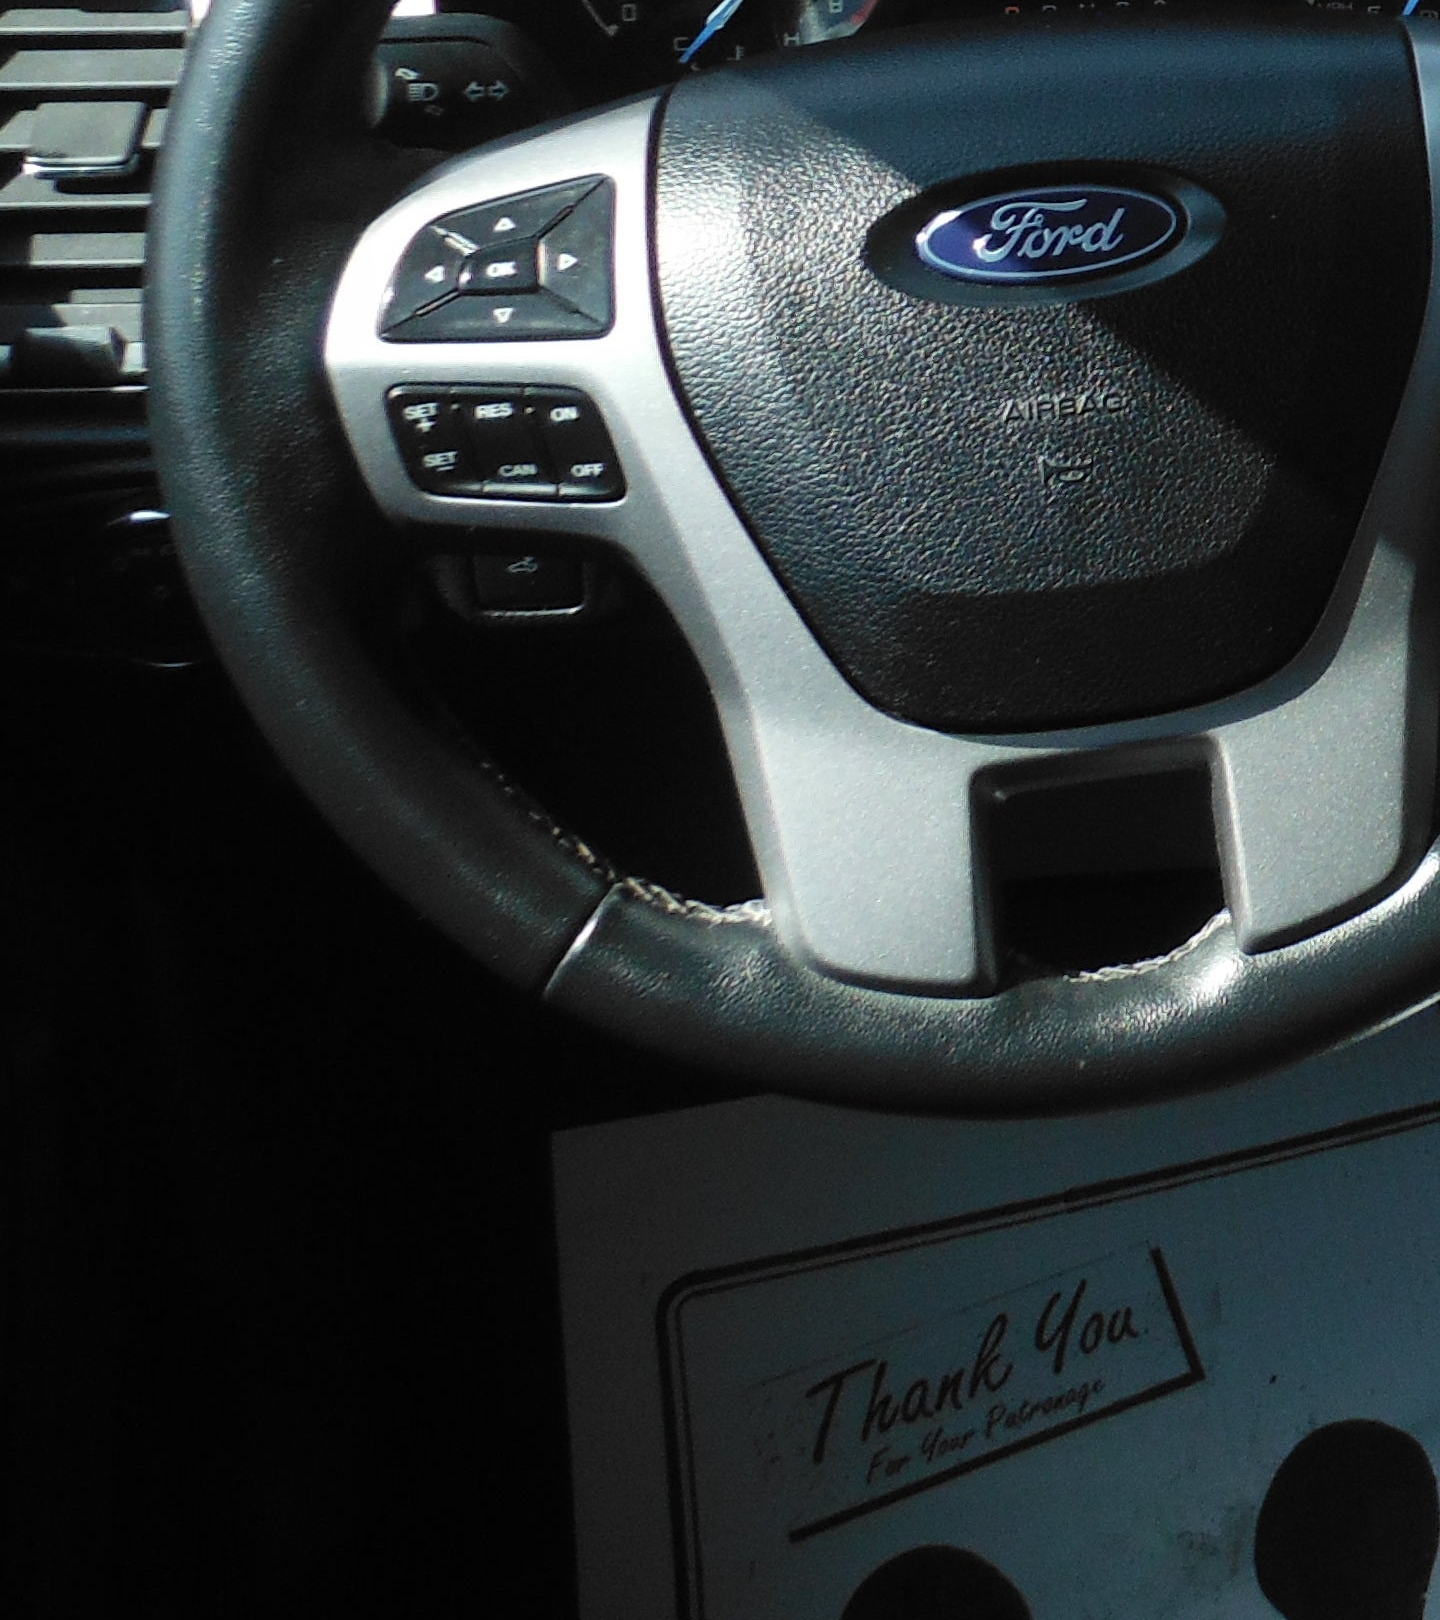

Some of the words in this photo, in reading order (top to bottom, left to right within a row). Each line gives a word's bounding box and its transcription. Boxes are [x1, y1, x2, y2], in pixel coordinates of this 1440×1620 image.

[622, 3, 638, 22] 0
[972, 198, 1125, 263] Ford
[486, 261, 518, 278] OK
[403, 402, 439, 420] SET
[474, 402, 514, 420] RES
[550, 406, 580, 422] ON
[1001, 393, 1128, 422] AIRBAG
[423, 451, 458, 468] SET
[498, 463, 538, 478] CAN
[570, 462, 604, 477] OFF
[805, 1313, 1014, 1465] Thank
[1035, 1279, 1140, 1374] You
[866, 1446, 911, 1483] For
[920, 1428, 976, 1462] Your
[985, 1380, 1106, 1438] Patronage
